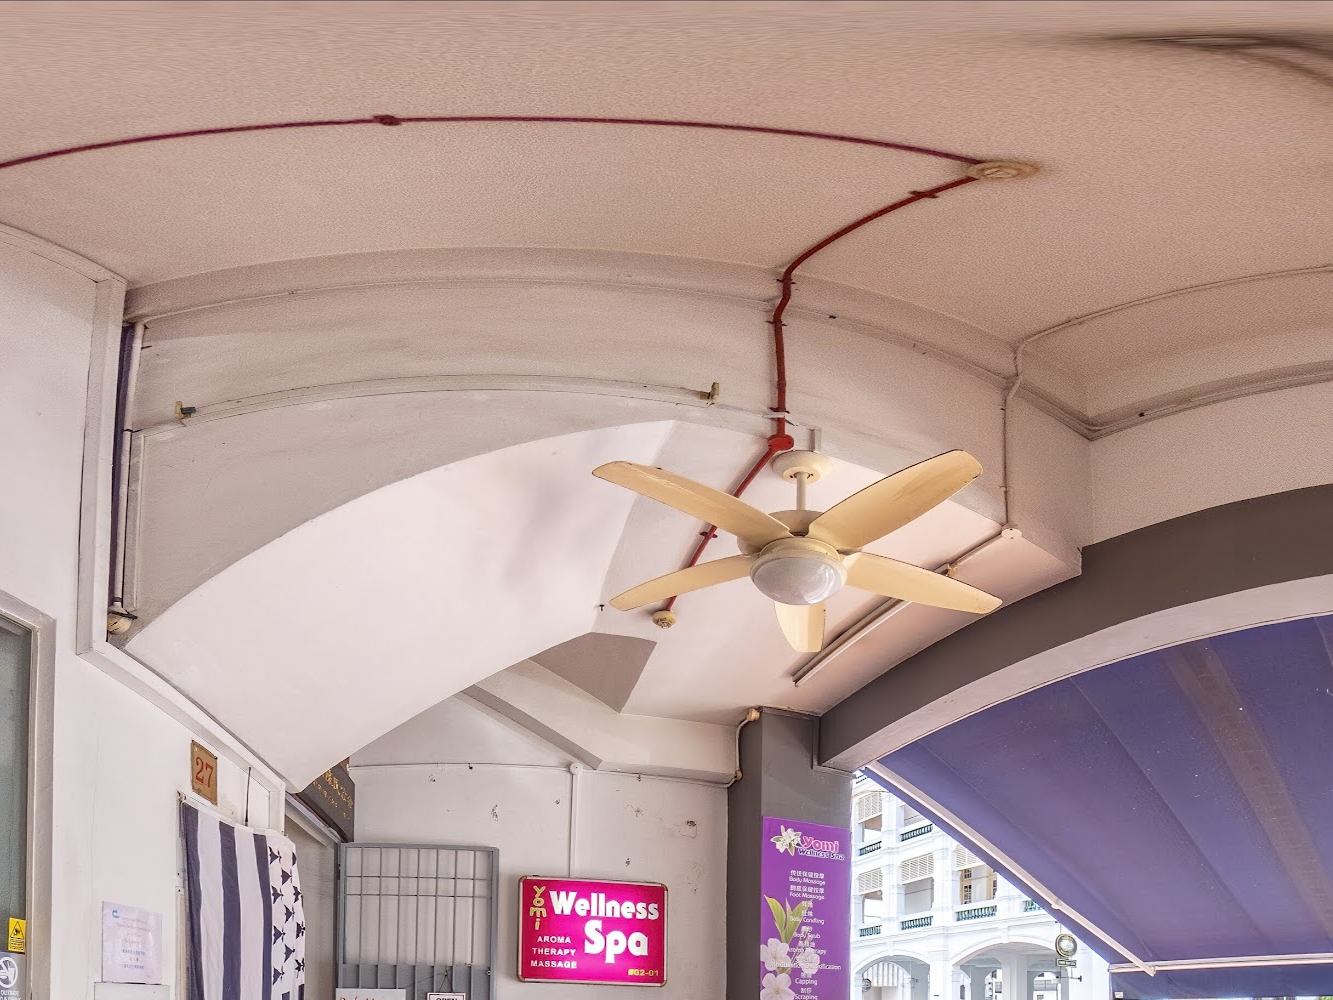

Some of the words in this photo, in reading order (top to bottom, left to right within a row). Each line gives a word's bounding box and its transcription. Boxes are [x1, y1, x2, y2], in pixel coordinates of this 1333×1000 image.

[196, 756, 214, 788] 27
[798, 848, 829, 859] Wellness
[830, 852, 845, 861] Spa
[789, 876, 802, 884] Body
[803, 878, 826, 886] Massage
[802, 892, 825, 900] Massage
[549, 890, 659, 920] Wellness
[537, 936, 571, 944] AROMA
[584, 919, 648, 964] Spa
[532, 948, 576, 956] THERAPY
[530, 960, 577, 969] MASSAGE
